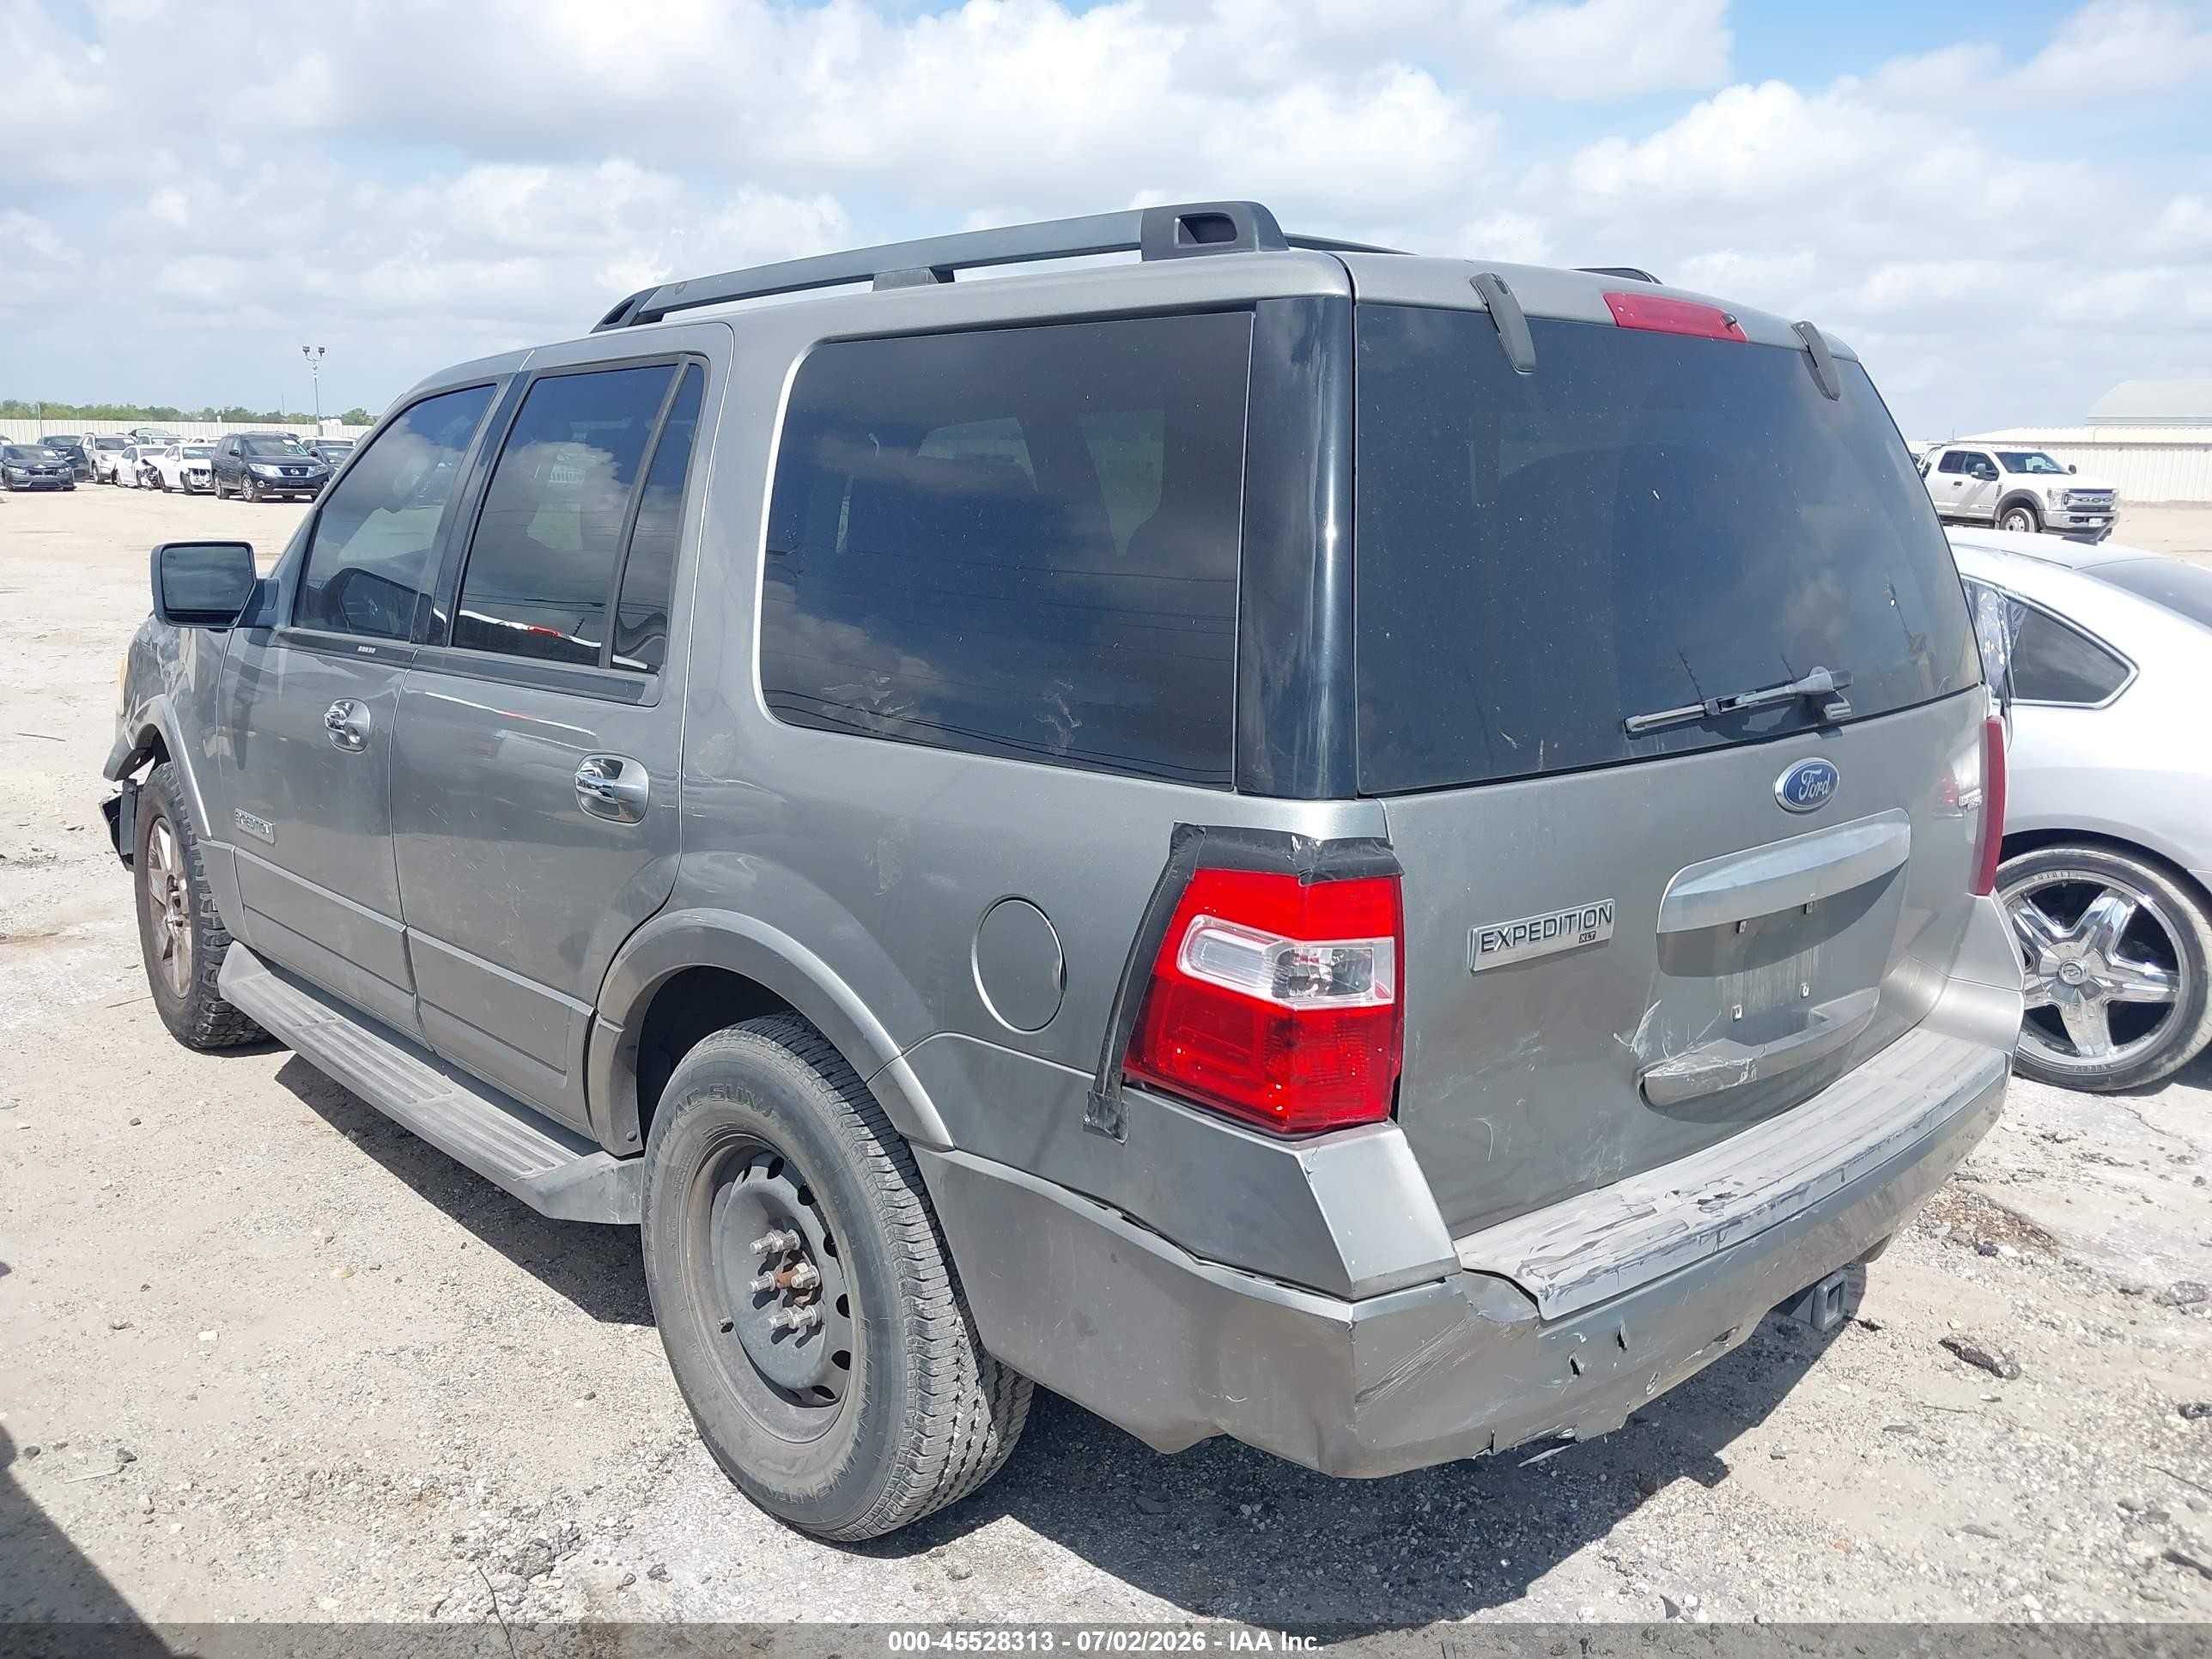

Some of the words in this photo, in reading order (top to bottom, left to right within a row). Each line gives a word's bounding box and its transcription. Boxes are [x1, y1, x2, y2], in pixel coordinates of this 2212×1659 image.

[1799, 769, 1831, 801] Ford
[1481, 904, 1613, 953] EXPEDITION
[1579, 931, 1597, 944] XLT
